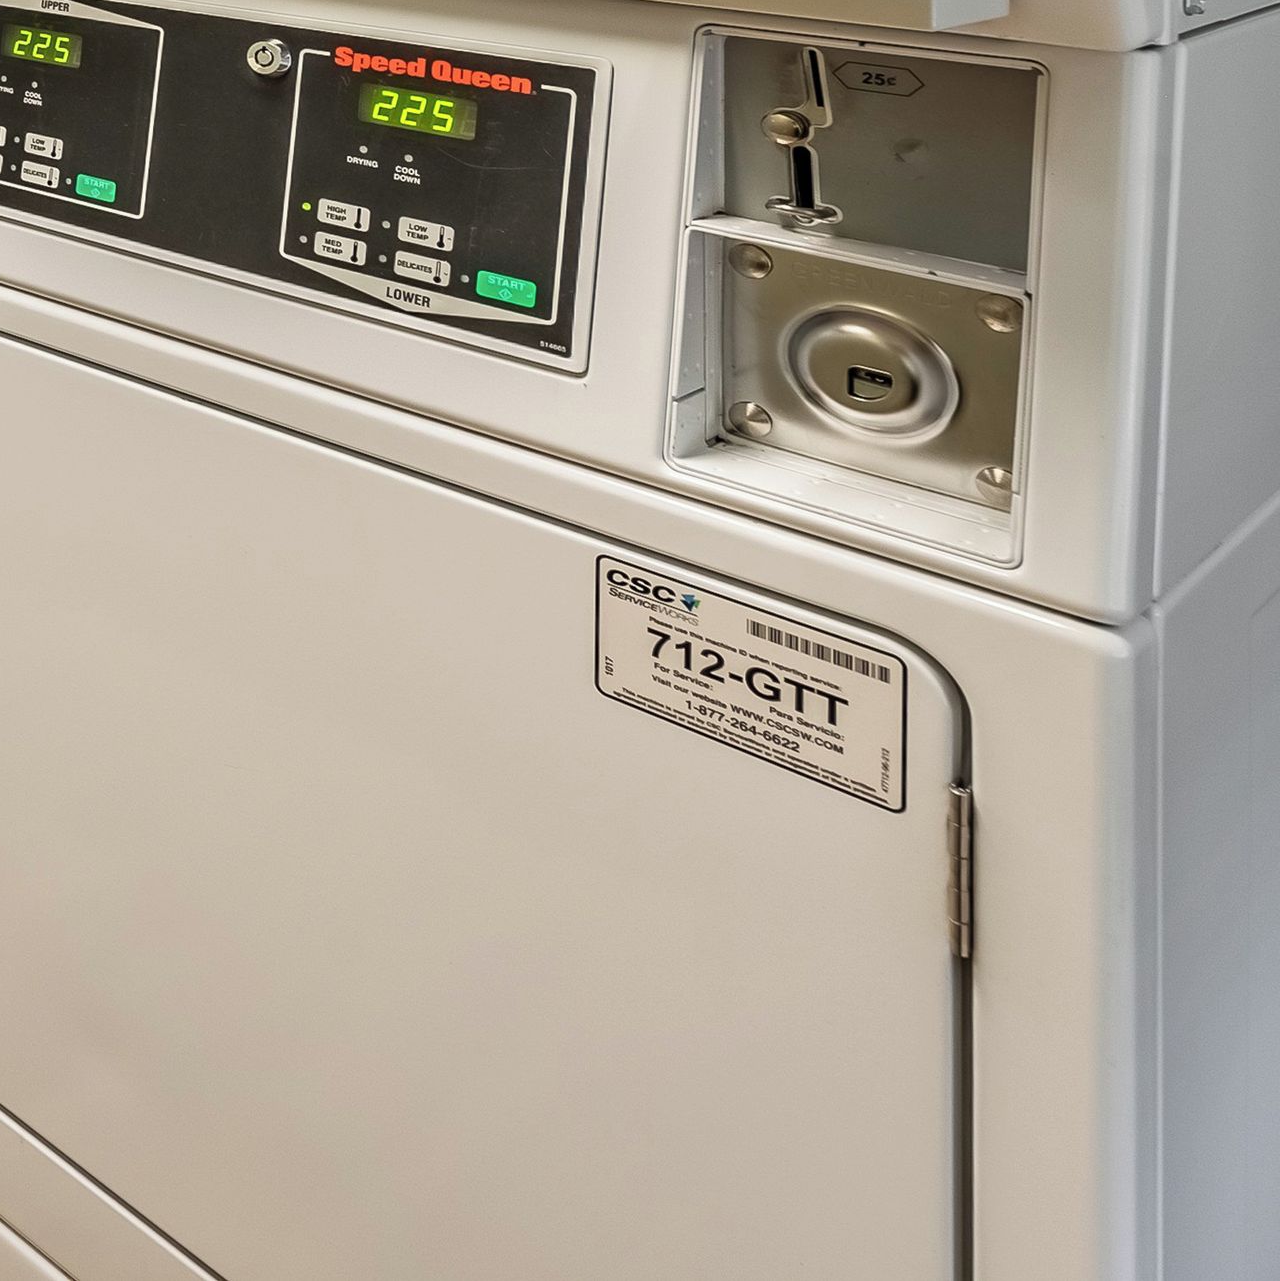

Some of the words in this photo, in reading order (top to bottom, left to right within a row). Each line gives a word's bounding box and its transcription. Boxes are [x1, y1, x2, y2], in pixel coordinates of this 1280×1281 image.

[41, 0, 70, 12] UPPER
[13, 30, 70, 62] 225
[334, 46, 426, 78] Speed
[431, 59, 532, 95] Queen
[23, 97, 42, 106] DOWN
[24, 91, 42, 100] COOL
[372, 90, 454, 132] 225
[346, 156, 378, 168] DRYING
[395, 165, 420, 177] COOL
[393, 173, 420, 185] DOWN
[325, 212, 346, 221] TEMP
[327, 205, 346, 215] HIGH
[409, 223, 428, 233] LOW
[406, 230, 429, 240] TEMP
[324, 238, 342, 247] MED
[322, 245, 343, 255] TEMP
[397, 259, 432, 274] DELICATES
[487, 274, 526, 290] START
[386, 286, 431, 308] LOWER
[606, 569, 676, 603] CSC
[647, 626, 849, 726] 712-GTT
[654, 662, 670, 674] For
[673, 670, 714, 691] Service:
[652, 674, 672, 688] Visit
[674, 684, 690, 694] our
[692, 690, 728, 710] website
[730, 704, 844, 754] WWW.CSCSW.COM
[685, 700, 800, 754] 1-877-264-6622
[770, 706, 794, 722] Para
[796, 716, 845, 742] Servicio:
